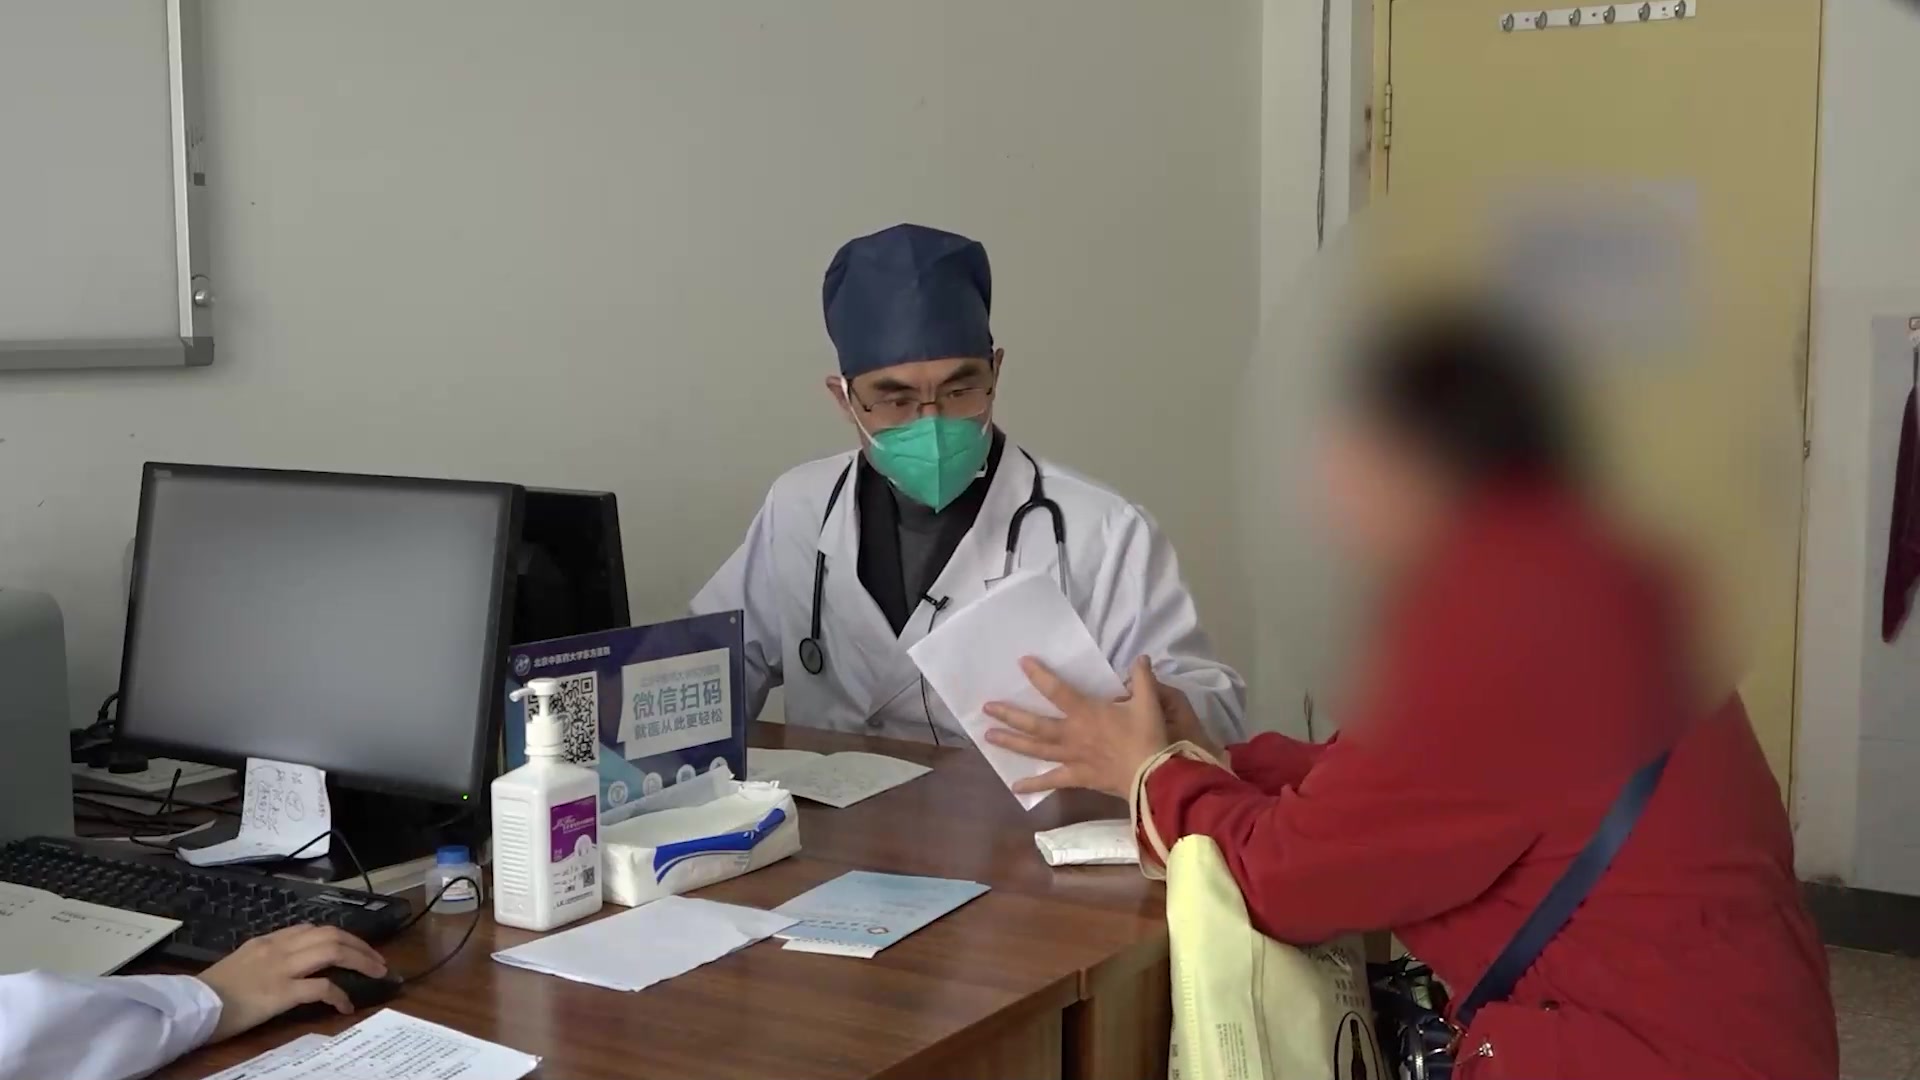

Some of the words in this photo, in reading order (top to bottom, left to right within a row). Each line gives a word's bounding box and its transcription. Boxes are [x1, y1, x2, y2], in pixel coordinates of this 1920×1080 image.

[633, 678, 722, 720] 微信扫码
[634, 708, 723, 740] 就医从此更轻松
